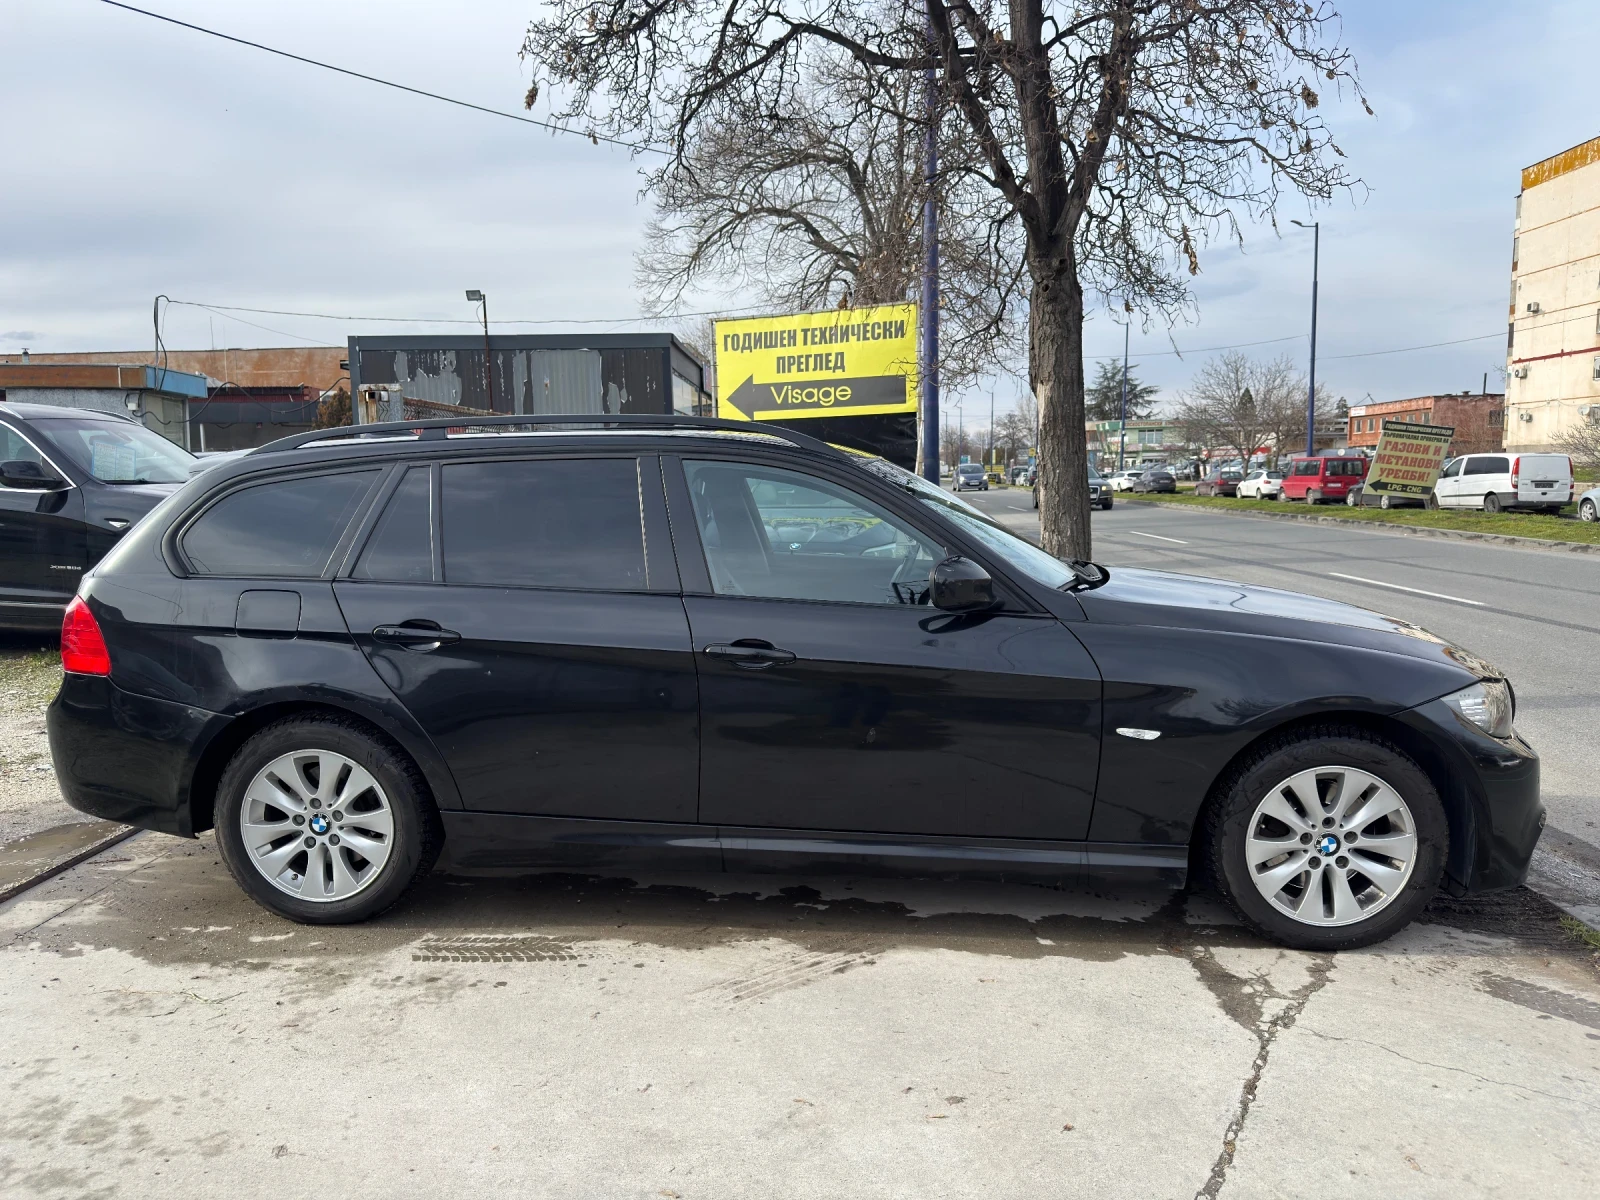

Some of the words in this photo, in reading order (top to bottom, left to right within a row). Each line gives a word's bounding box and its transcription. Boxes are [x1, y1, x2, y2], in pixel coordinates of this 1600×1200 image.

[723, 328, 797, 353] ГОДИШЕН
[801, 319, 906, 346] ТЕХНИЧЕСКИ
[776, 351, 846, 374] ПРЕГЛЕД
[770, 385, 852, 407] Visage
[1383, 440, 1431, 455] ГАЗОВИ
[1432, 445, 1442, 456] И
[1375, 453, 1442, 470] МЕТАНОВИ
[1378, 467, 1431, 483] УРЕДБИ!
[1406, 485, 1422, 493] CNG
